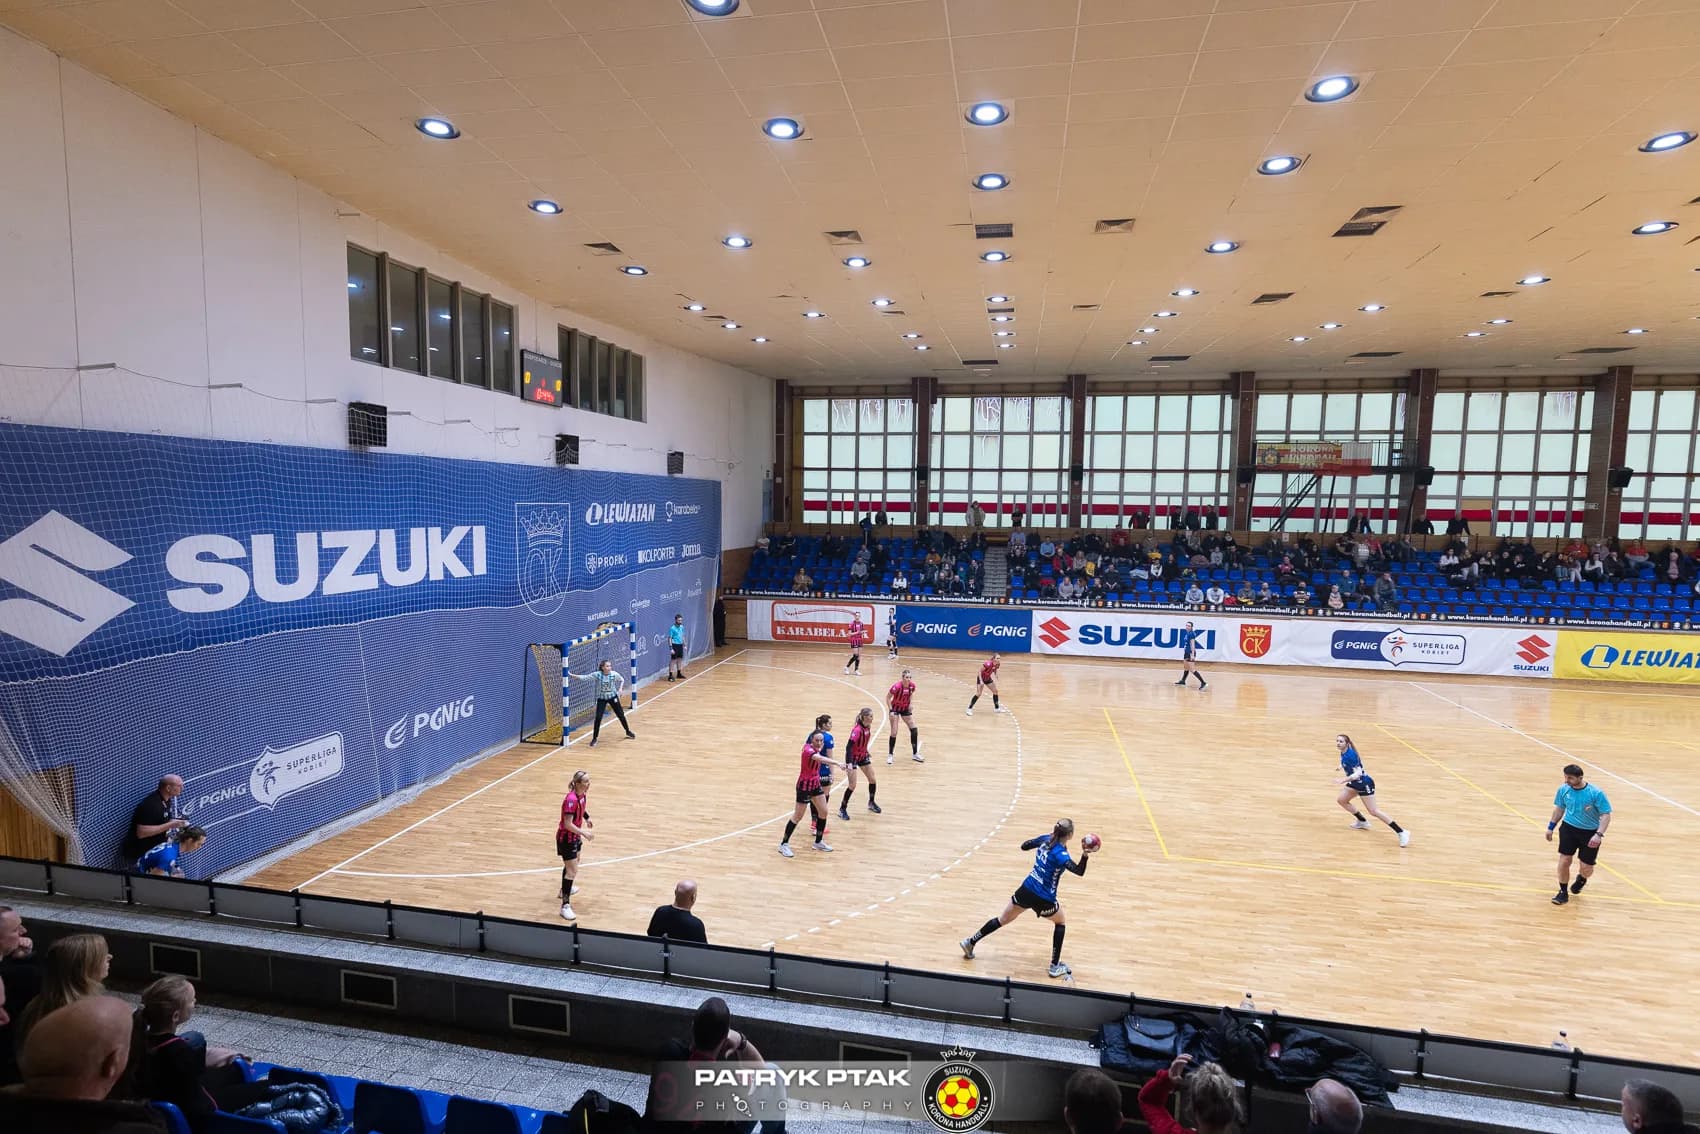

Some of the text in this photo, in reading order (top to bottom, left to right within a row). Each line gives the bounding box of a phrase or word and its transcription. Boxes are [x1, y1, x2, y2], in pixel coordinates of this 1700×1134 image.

[604, 500, 656, 523] LEWIATAN
[166, 525, 487, 613] SUZUKI
[915, 623, 958, 634] PGNiG
[983, 625, 1027, 637] PGNiG
[1567, 618, 1651, 628] www.koronahandball.pl
[1078, 624, 1216, 650] SUZUKI
[1242, 637, 1264, 654] CK
[1346, 641, 1378, 650] PGNiG
[1412, 642, 1460, 650] SUPERLIGA
[1513, 664, 1549, 672] SUZUKI
[413, 695, 474, 738] PGNiG
[286, 747, 337, 770] SUPERLIGA
[199, 783, 247, 809] PGNiG
